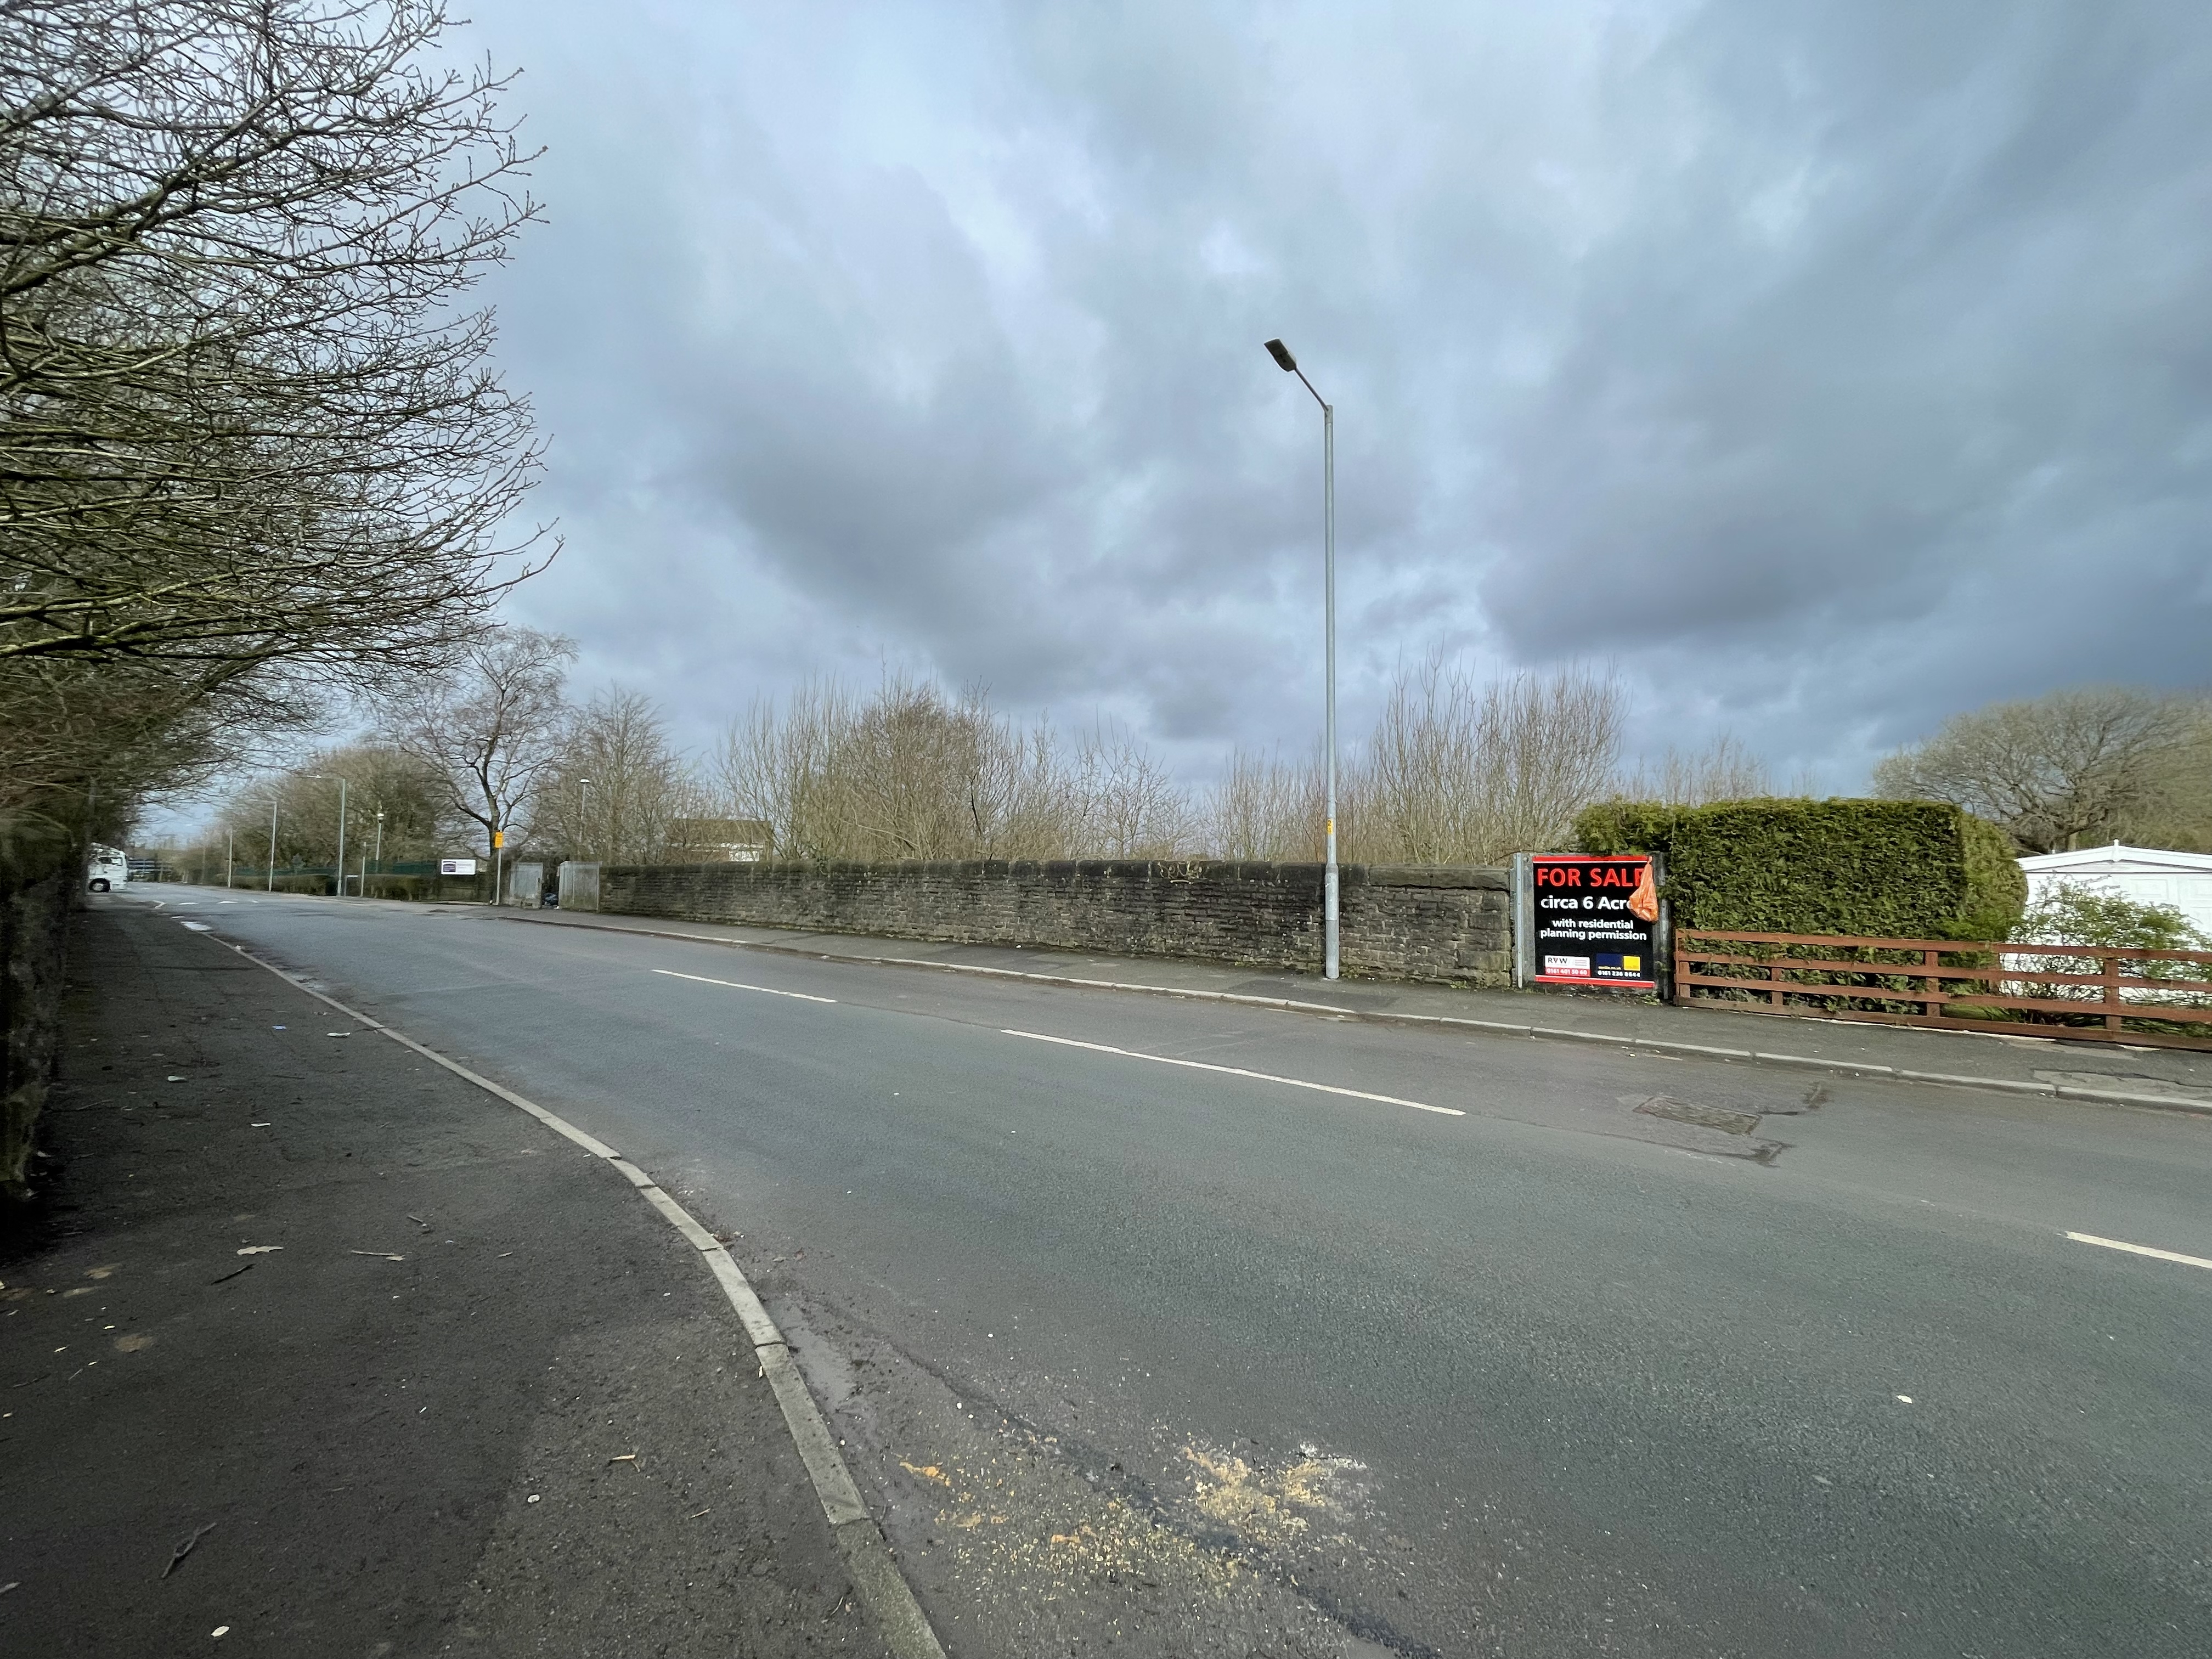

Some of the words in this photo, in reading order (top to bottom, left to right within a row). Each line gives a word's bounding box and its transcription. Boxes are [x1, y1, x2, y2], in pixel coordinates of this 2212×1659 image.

[1538, 868, 1581, 887] FOR
[1541, 895, 1578, 910] circa
[1583, 896, 1593, 910] 6
[1552, 918, 1576, 928] with
[1578, 919, 1633, 929] residential
[1541, 928, 1585, 940] planning
[1588, 930, 1647, 940] permission
